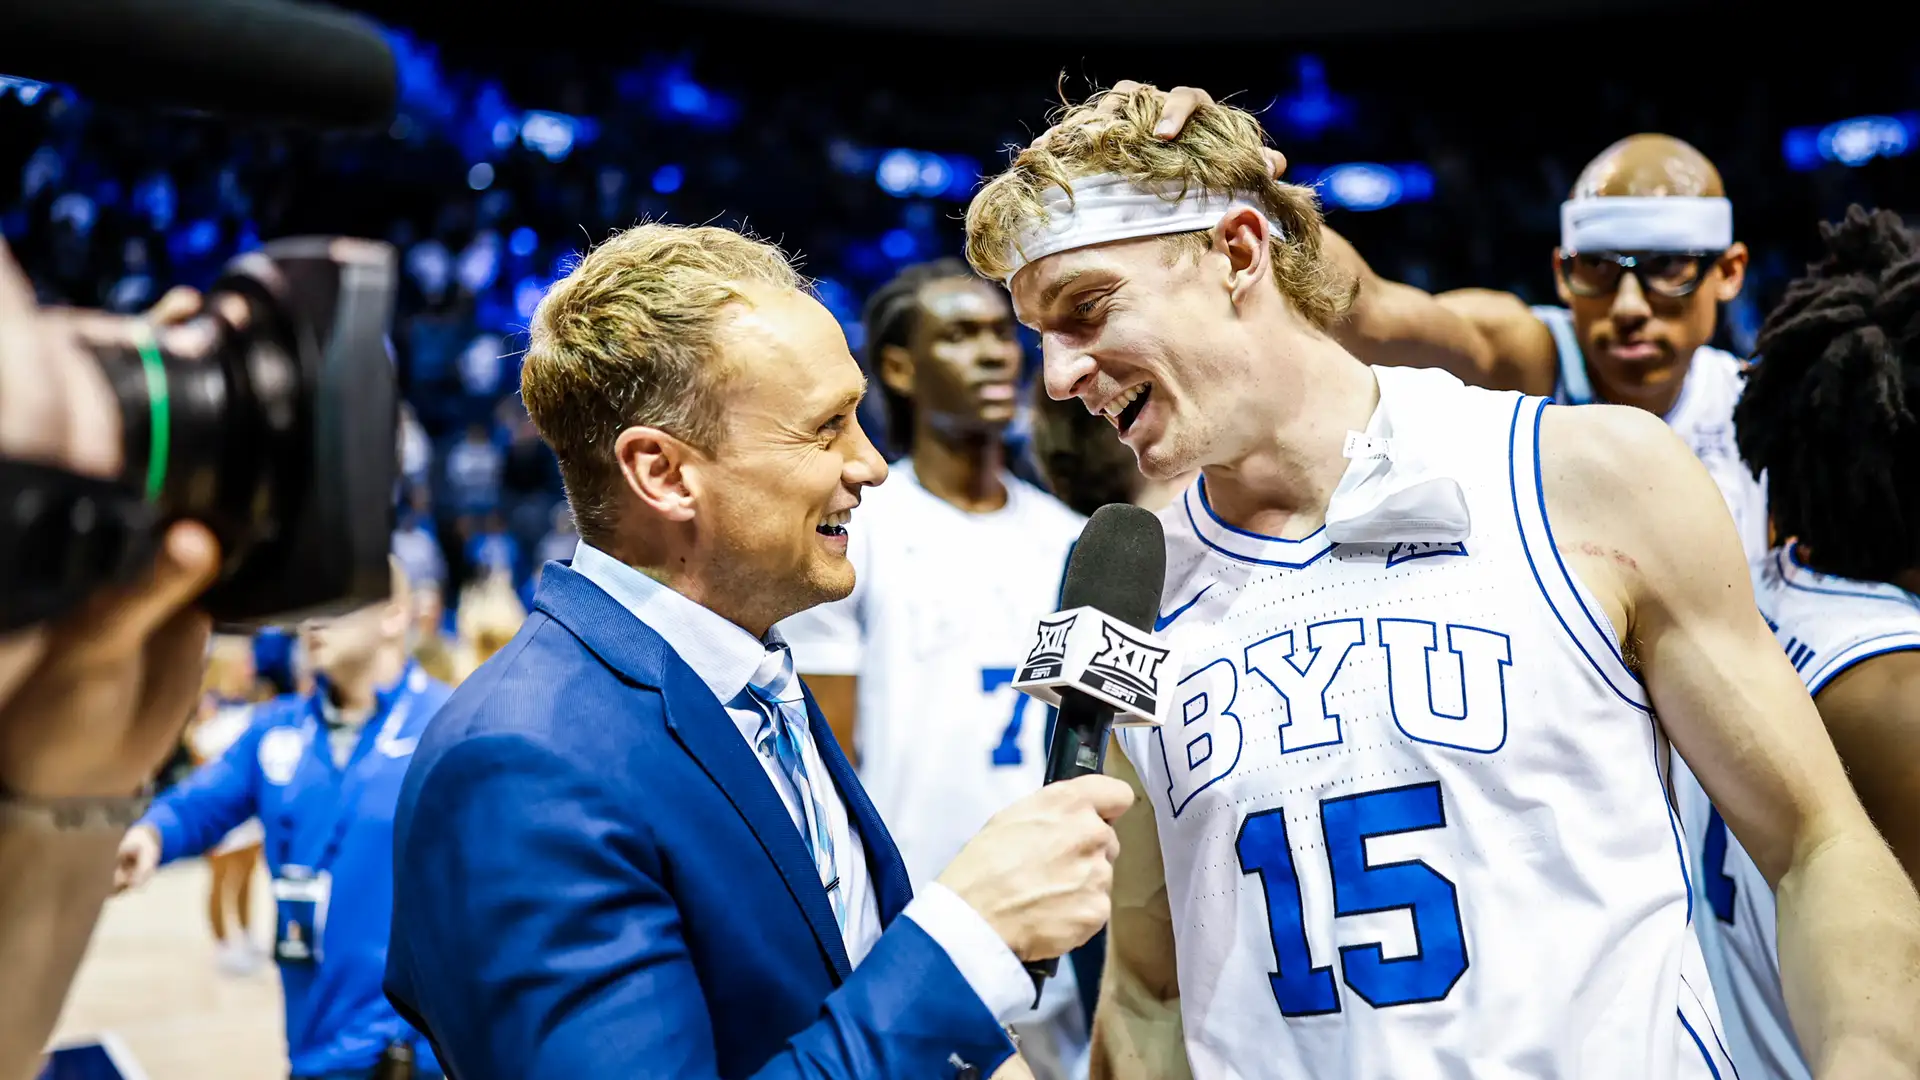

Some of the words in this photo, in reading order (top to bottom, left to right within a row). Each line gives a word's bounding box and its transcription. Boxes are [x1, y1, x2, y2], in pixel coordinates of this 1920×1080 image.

[981, 667, 1031, 765] 7
[1101, 680, 1138, 704] ESPN
[1153, 618, 1513, 818] BYU
[1235, 781, 1470, 1017] 15
